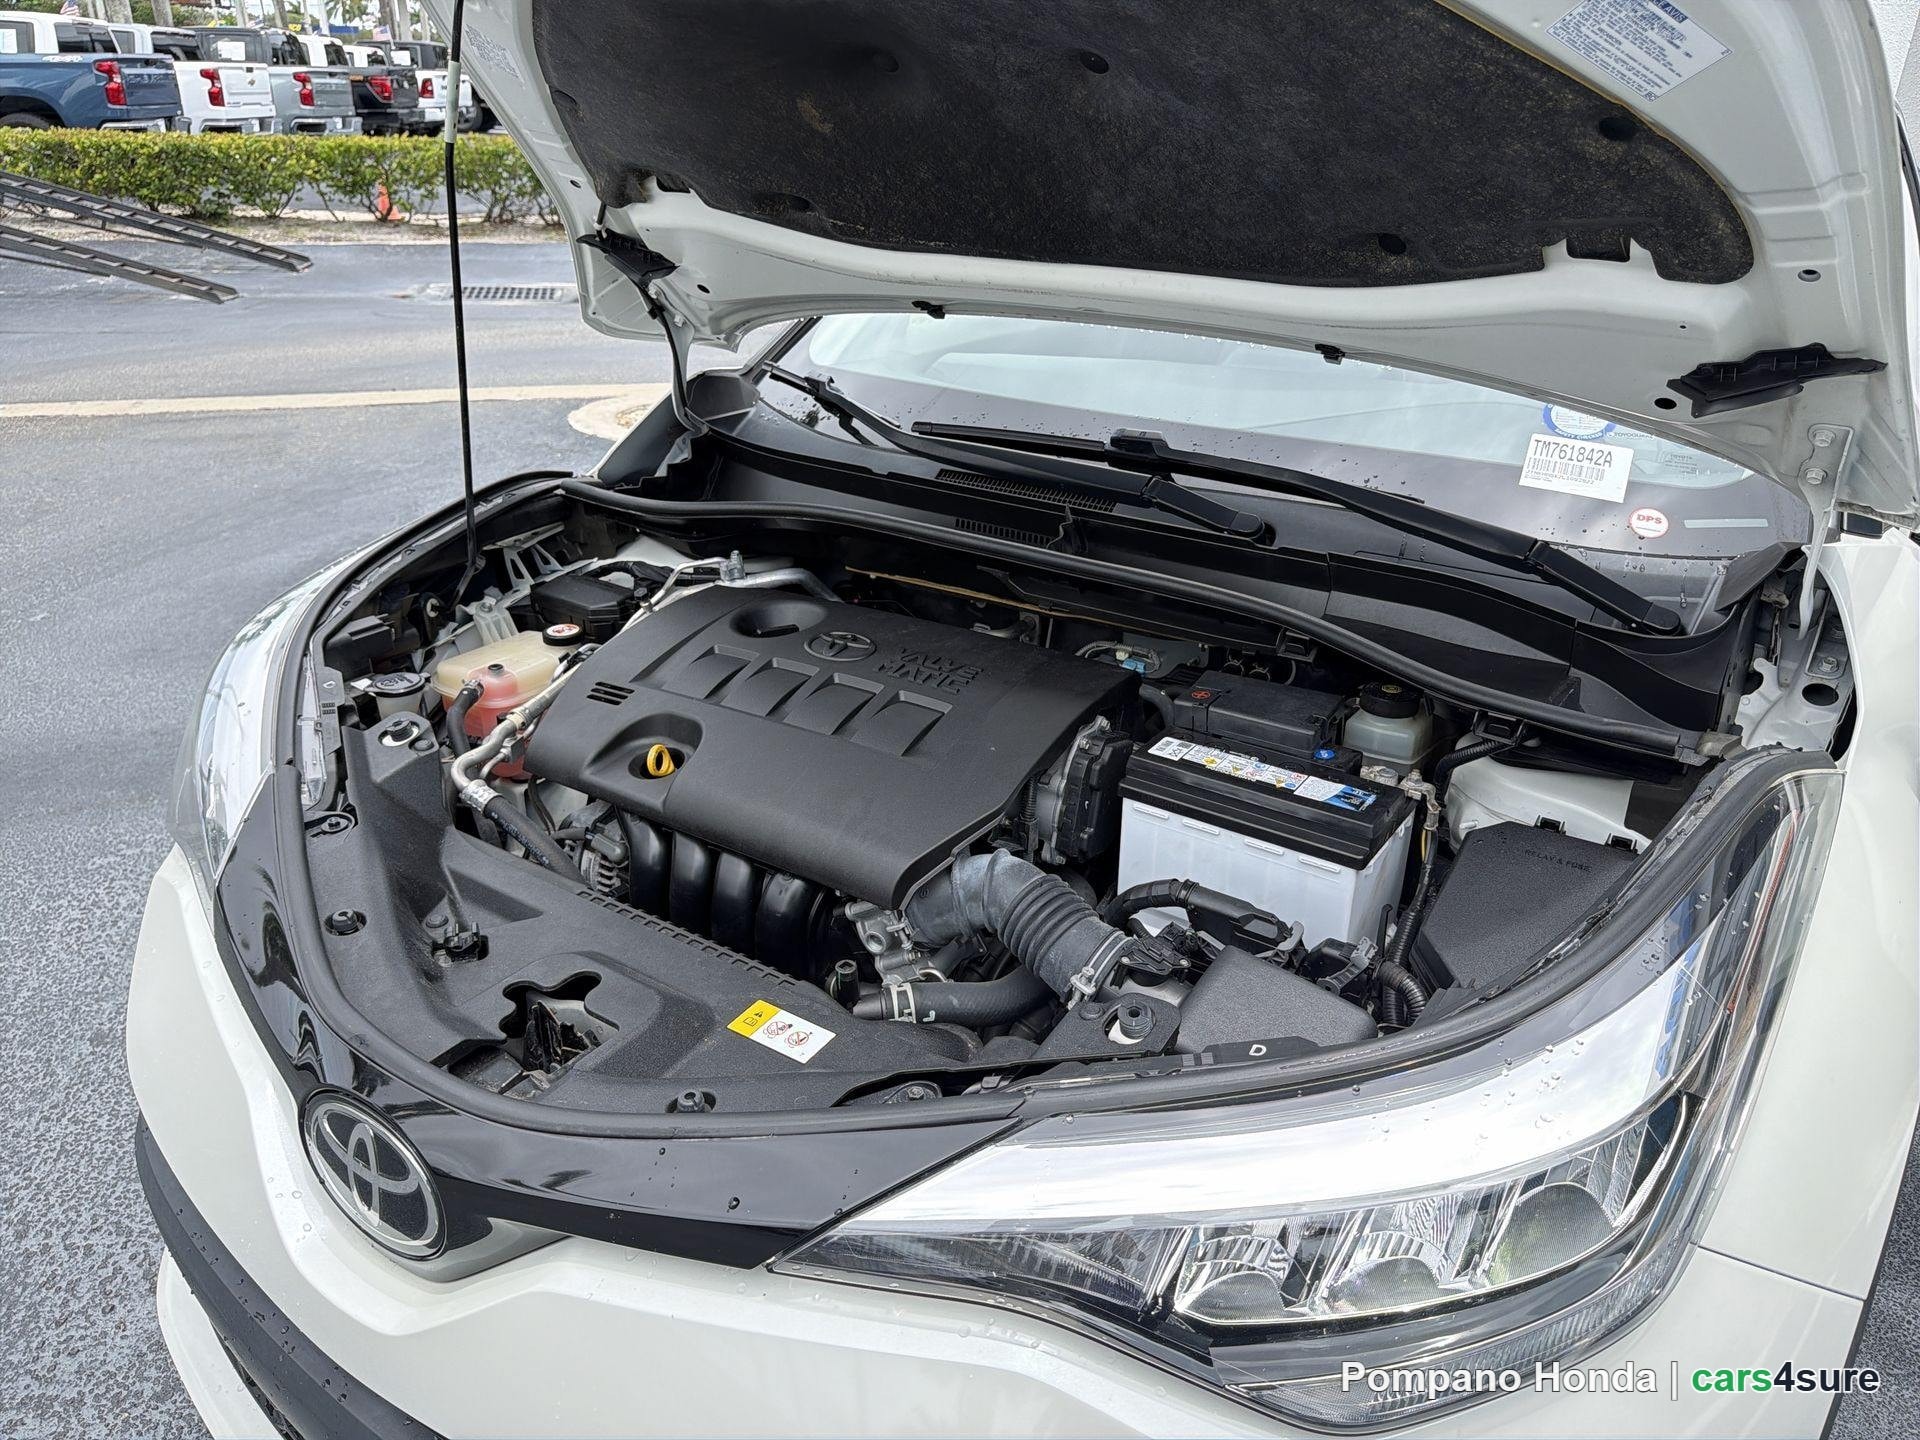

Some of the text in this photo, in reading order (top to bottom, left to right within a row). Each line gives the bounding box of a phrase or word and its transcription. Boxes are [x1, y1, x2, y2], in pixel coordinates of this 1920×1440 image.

[1533, 439, 1613, 468] TM761842A
[1636, 513, 1663, 524] DPS
[1248, 1044, 1267, 1056] D
